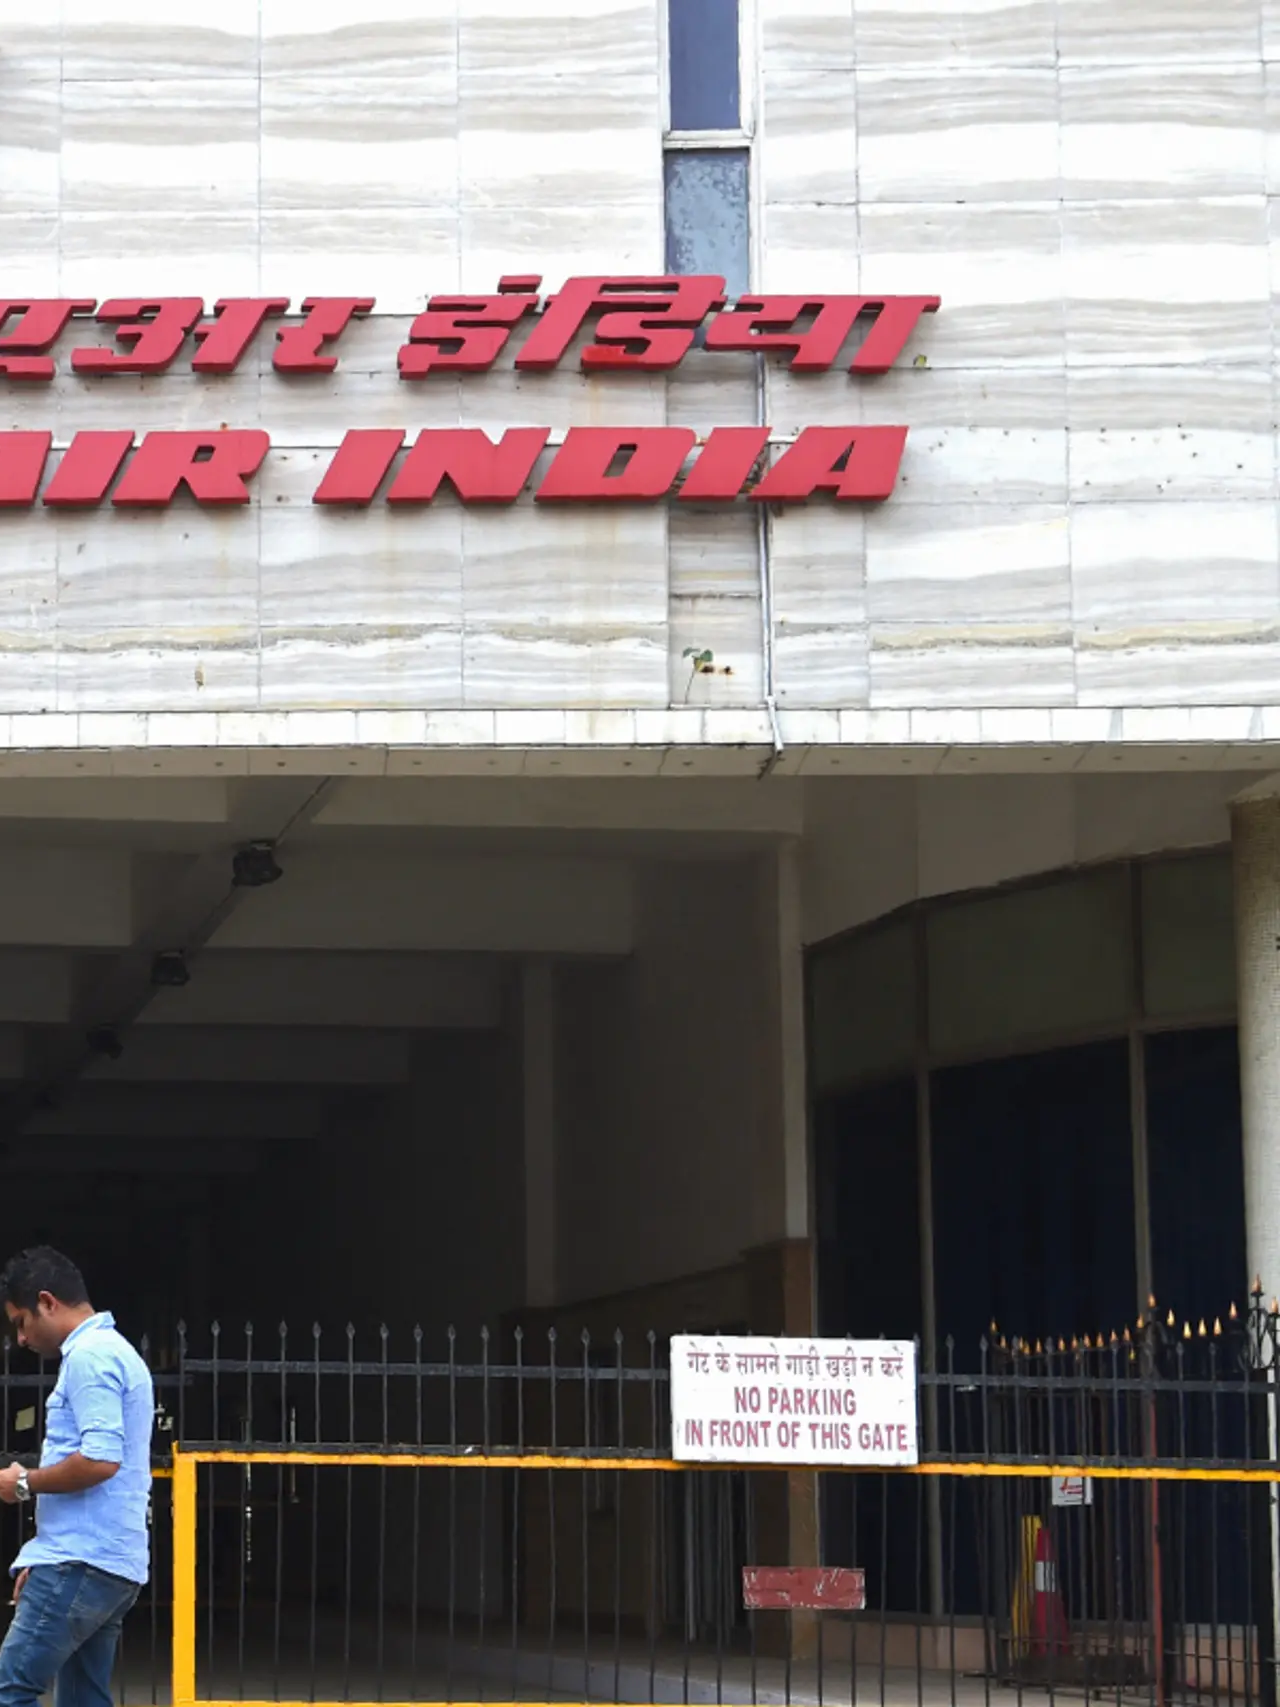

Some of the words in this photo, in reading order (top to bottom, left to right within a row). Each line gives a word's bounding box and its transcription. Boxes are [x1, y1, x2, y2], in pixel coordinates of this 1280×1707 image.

[397, 274, 941, 380] इंडिया
[313, 425, 908, 505] INDIA
[715, 1342, 730, 1373] के
[861, 1356, 873, 1376] न
[734, 1386, 761, 1413] NO
[768, 1387, 856, 1416] PARKING
[685, 1419, 703, 1446] IN
[710, 1420, 771, 1448] FRONT
[777, 1422, 800, 1448] OF
[809, 1423, 852, 1449] THIS
[858, 1424, 907, 1451] GATE
